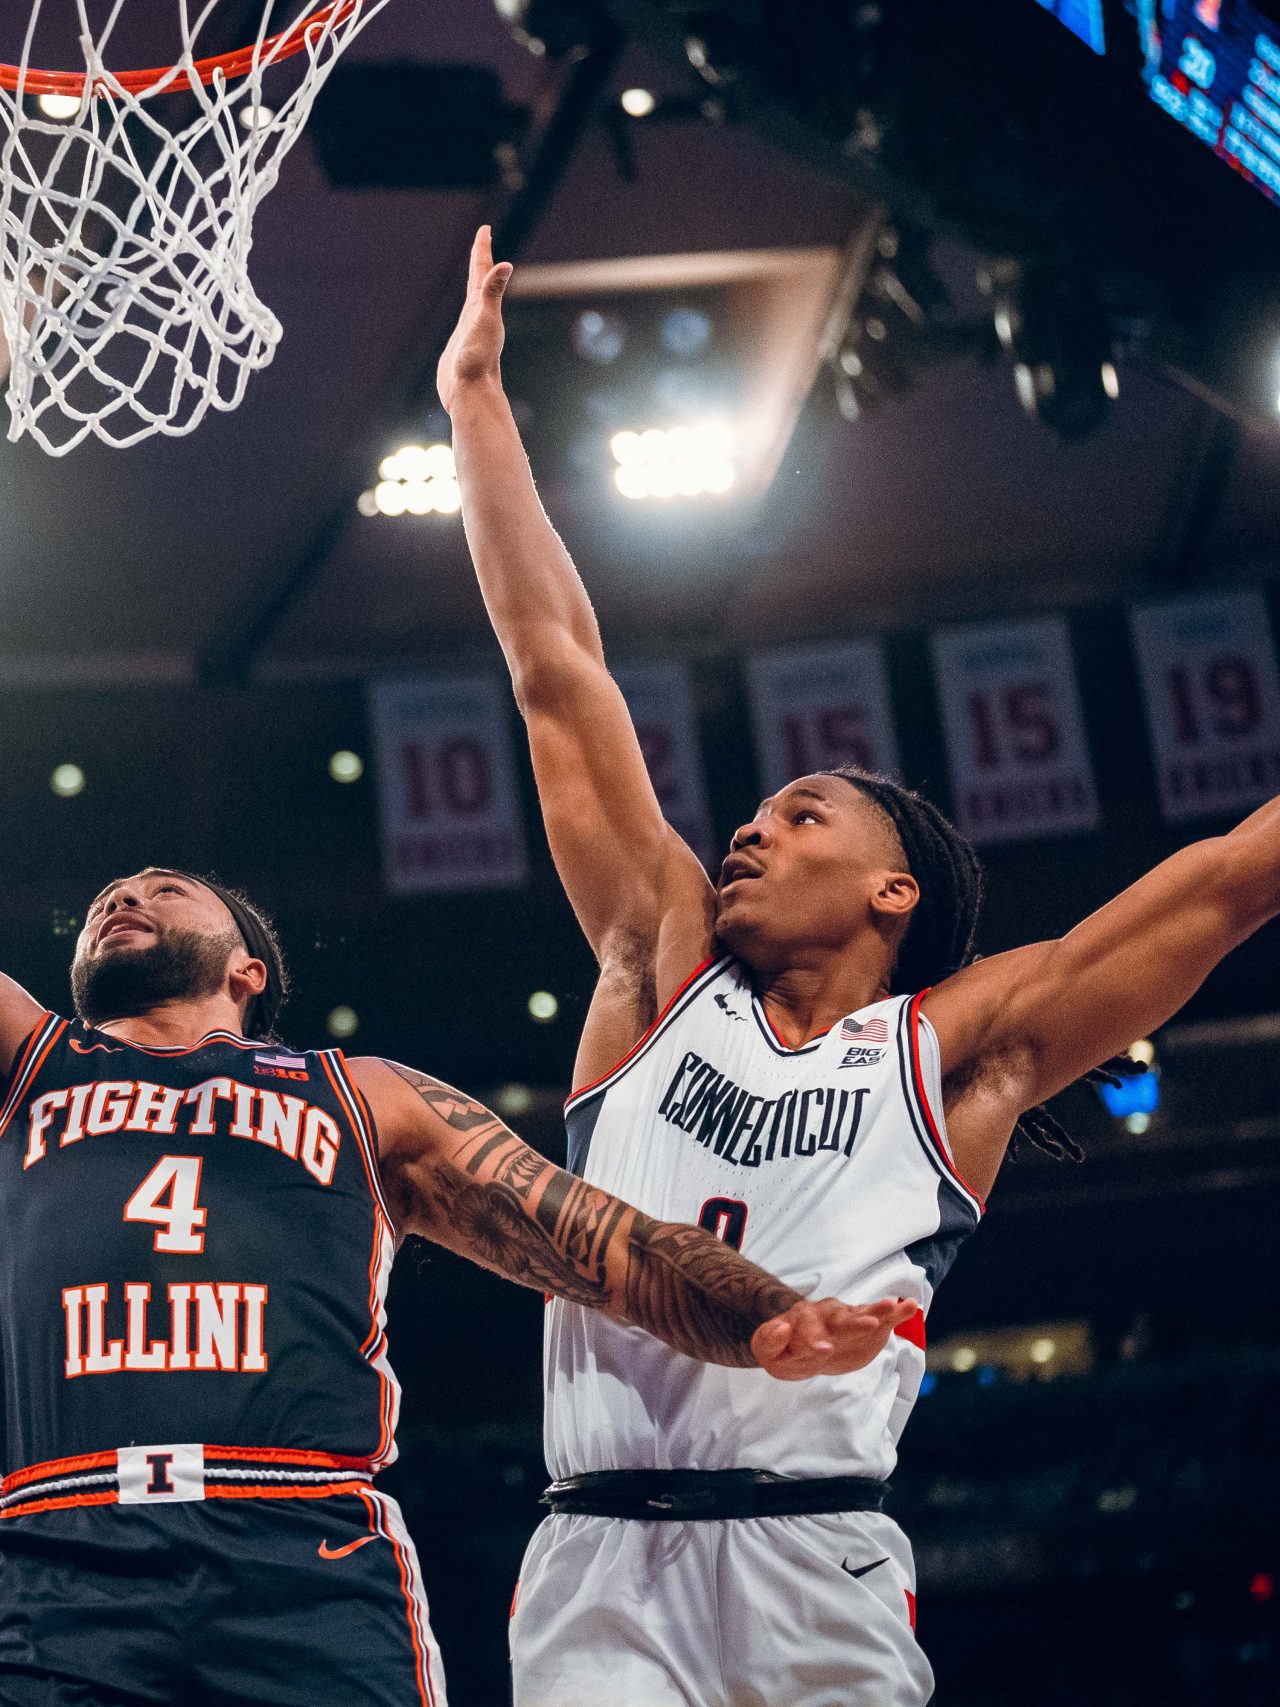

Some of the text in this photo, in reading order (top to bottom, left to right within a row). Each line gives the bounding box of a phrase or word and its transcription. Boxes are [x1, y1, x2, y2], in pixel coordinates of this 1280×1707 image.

[971, 680, 1060, 771] 15
[1168, 655, 1263, 747] 19
[404, 736, 492, 820] 10
[846, 1047, 882, 1056] BIG
[24, 1078, 341, 1186] FIGHTING
[658, 1051, 870, 1167] CONNECTICUT
[123, 1155, 207, 1254] 4
[62, 1282, 268, 1379] ILLINI
[146, 1453, 175, 1494] I
